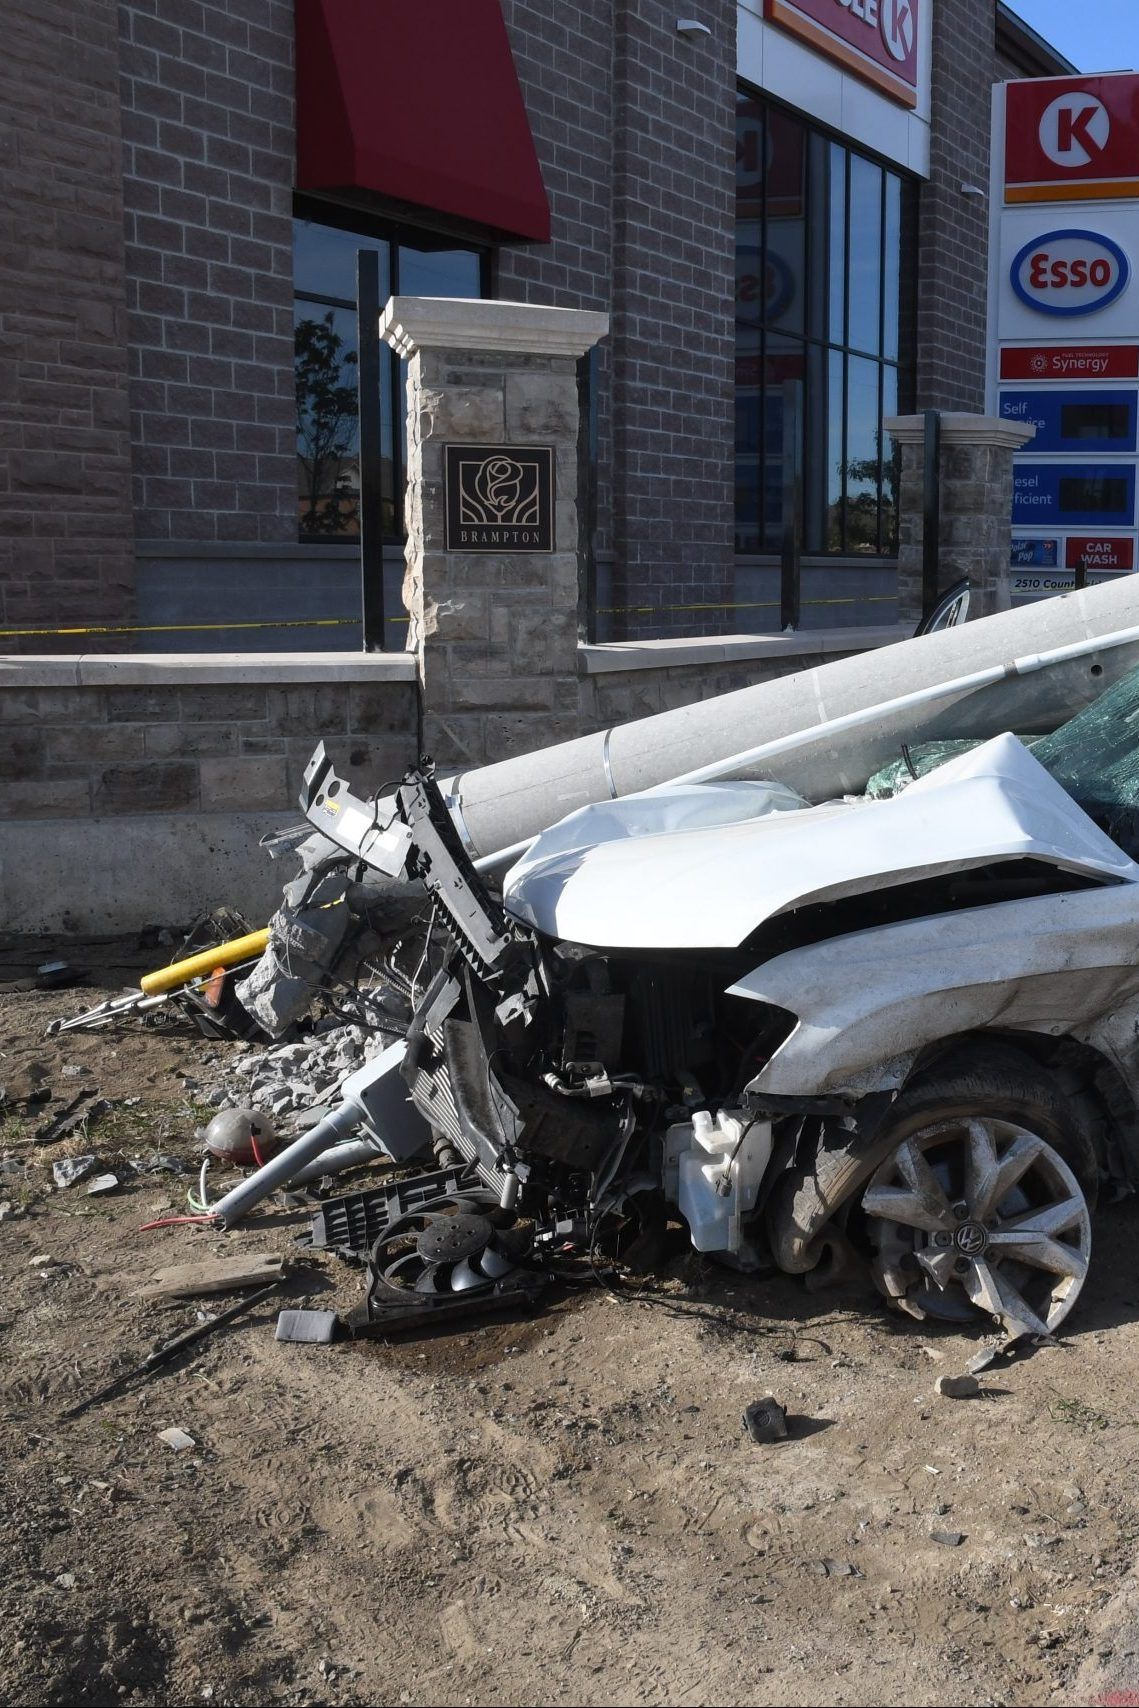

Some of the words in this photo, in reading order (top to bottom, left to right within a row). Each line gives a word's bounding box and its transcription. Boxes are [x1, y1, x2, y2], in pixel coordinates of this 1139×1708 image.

[1058, 106, 1104, 162] K
[1030, 253, 1111, 289] Esso
[1053, 356, 1109, 372] Synergy
[1003, 402, 1028, 415] Self
[1015, 474, 1038, 488] esel
[1015, 491, 1052, 505] ficient
[461, 531, 540, 543] BRAMPTON
[1086, 543, 1112, 553] CAR
[1081, 554, 1118, 565] WASH
[1015, 579, 1040, 588] 2510
